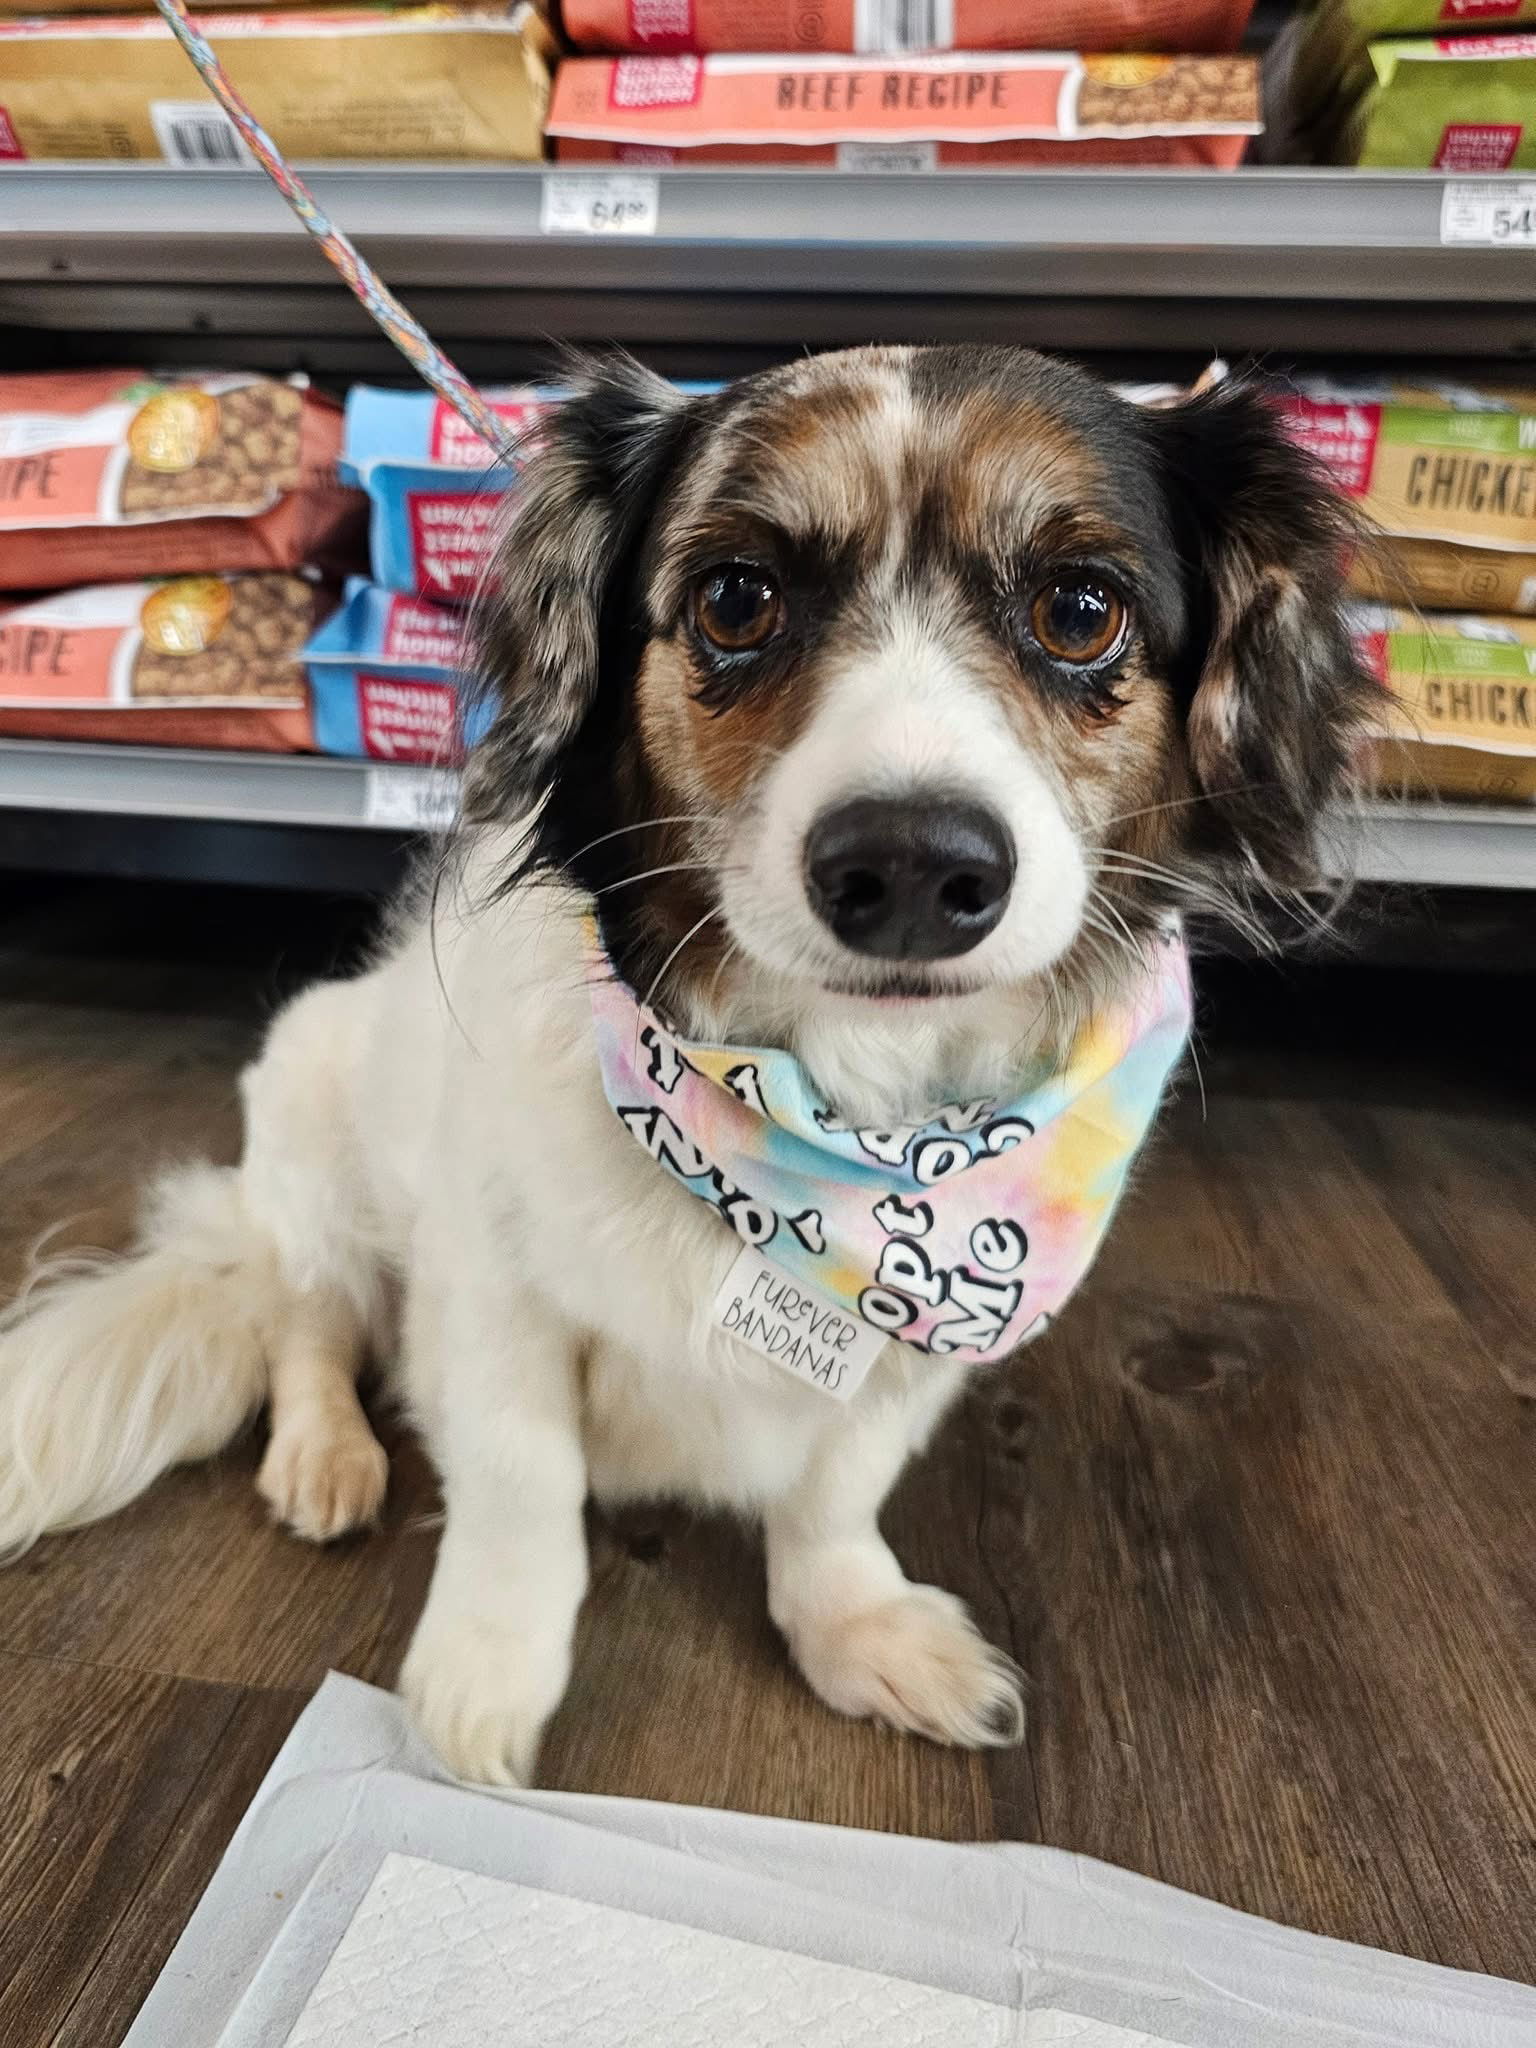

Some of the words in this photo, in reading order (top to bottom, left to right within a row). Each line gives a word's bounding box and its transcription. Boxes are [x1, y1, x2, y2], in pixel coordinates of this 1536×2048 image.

[777, 74, 864, 112] BEEF
[931, 1217, 1029, 1355] Me
[721, 1294, 850, 1393] BANDANAS
